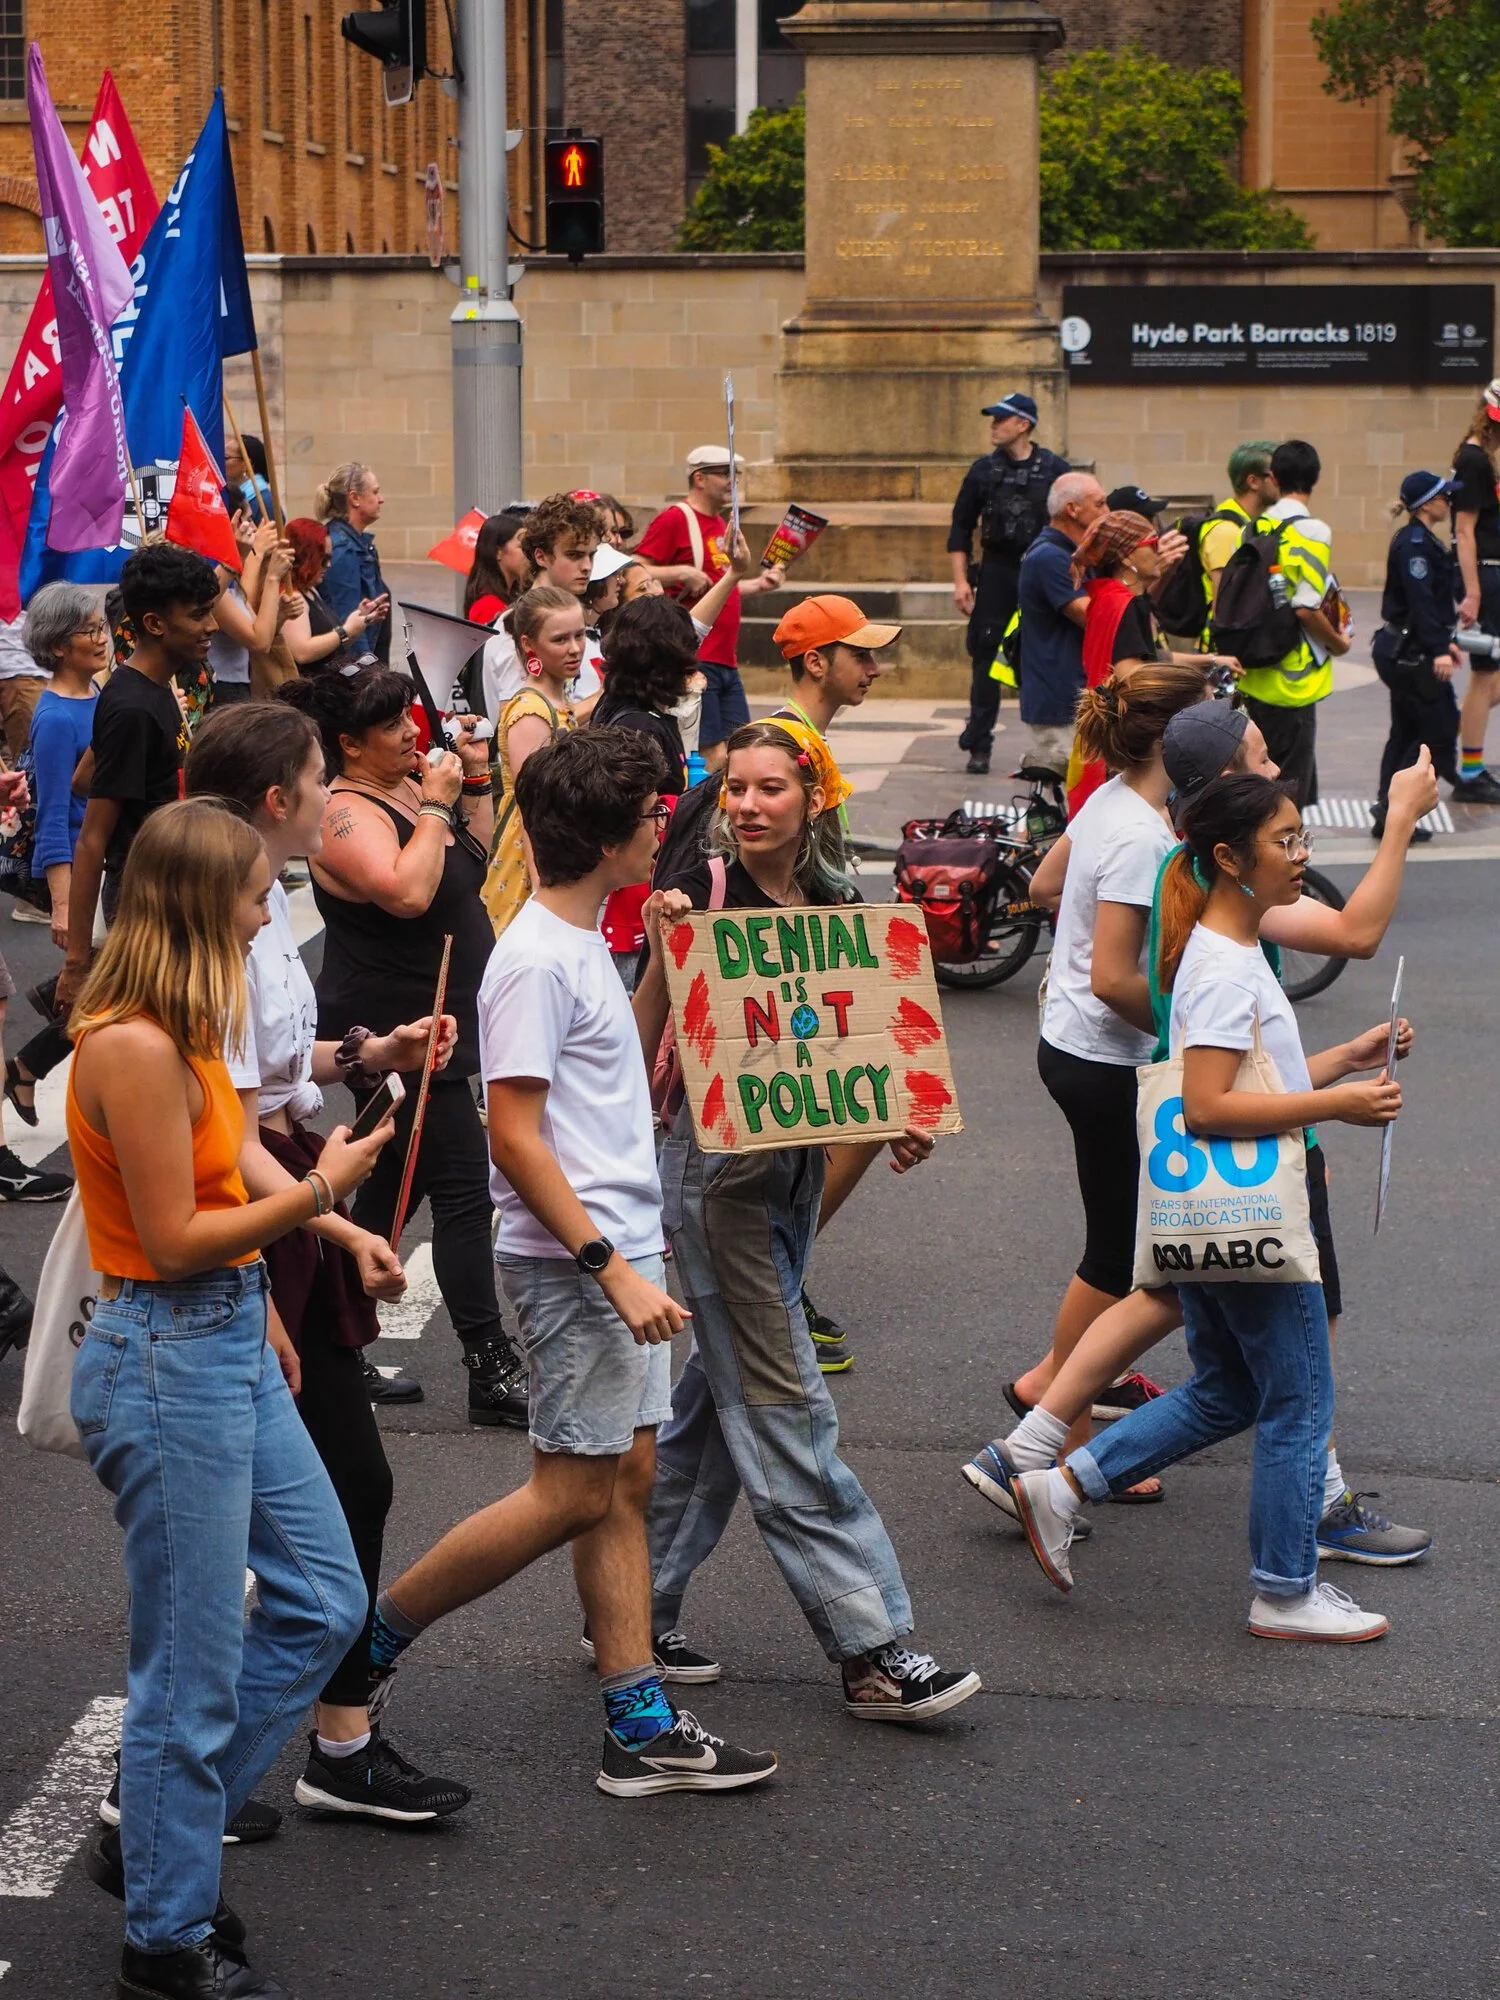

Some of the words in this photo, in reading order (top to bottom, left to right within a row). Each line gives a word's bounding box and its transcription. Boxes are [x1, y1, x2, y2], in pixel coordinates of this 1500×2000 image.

[830, 163, 909, 181] ALBERT
[835, 239, 902, 260] QUEEN
[908, 239, 1005, 257] VICTORIA
[1132, 323, 1189, 348] Hyde
[1193, 322, 1245, 343] Park
[1250, 322, 1350, 343] Barracks
[1354, 322, 1397, 343] 1819
[109, 395, 128, 482] Union
[712, 913, 879, 979] DENIAL
[781, 977, 808, 1002] IS
[796, 1041, 813, 1068] A
[737, 1063, 890, 1133] POLICY
[1148, 1096, 1279, 1193] 80
[1150, 1200, 1181, 1210] YEARS
[1183, 1199, 1196, 1209] OF
[1197, 1194, 1281, 1209] INTERNATIONAL
[1150, 1207, 1282, 1227] BROADCASTING
[1201, 1237, 1286, 1271] ABC
